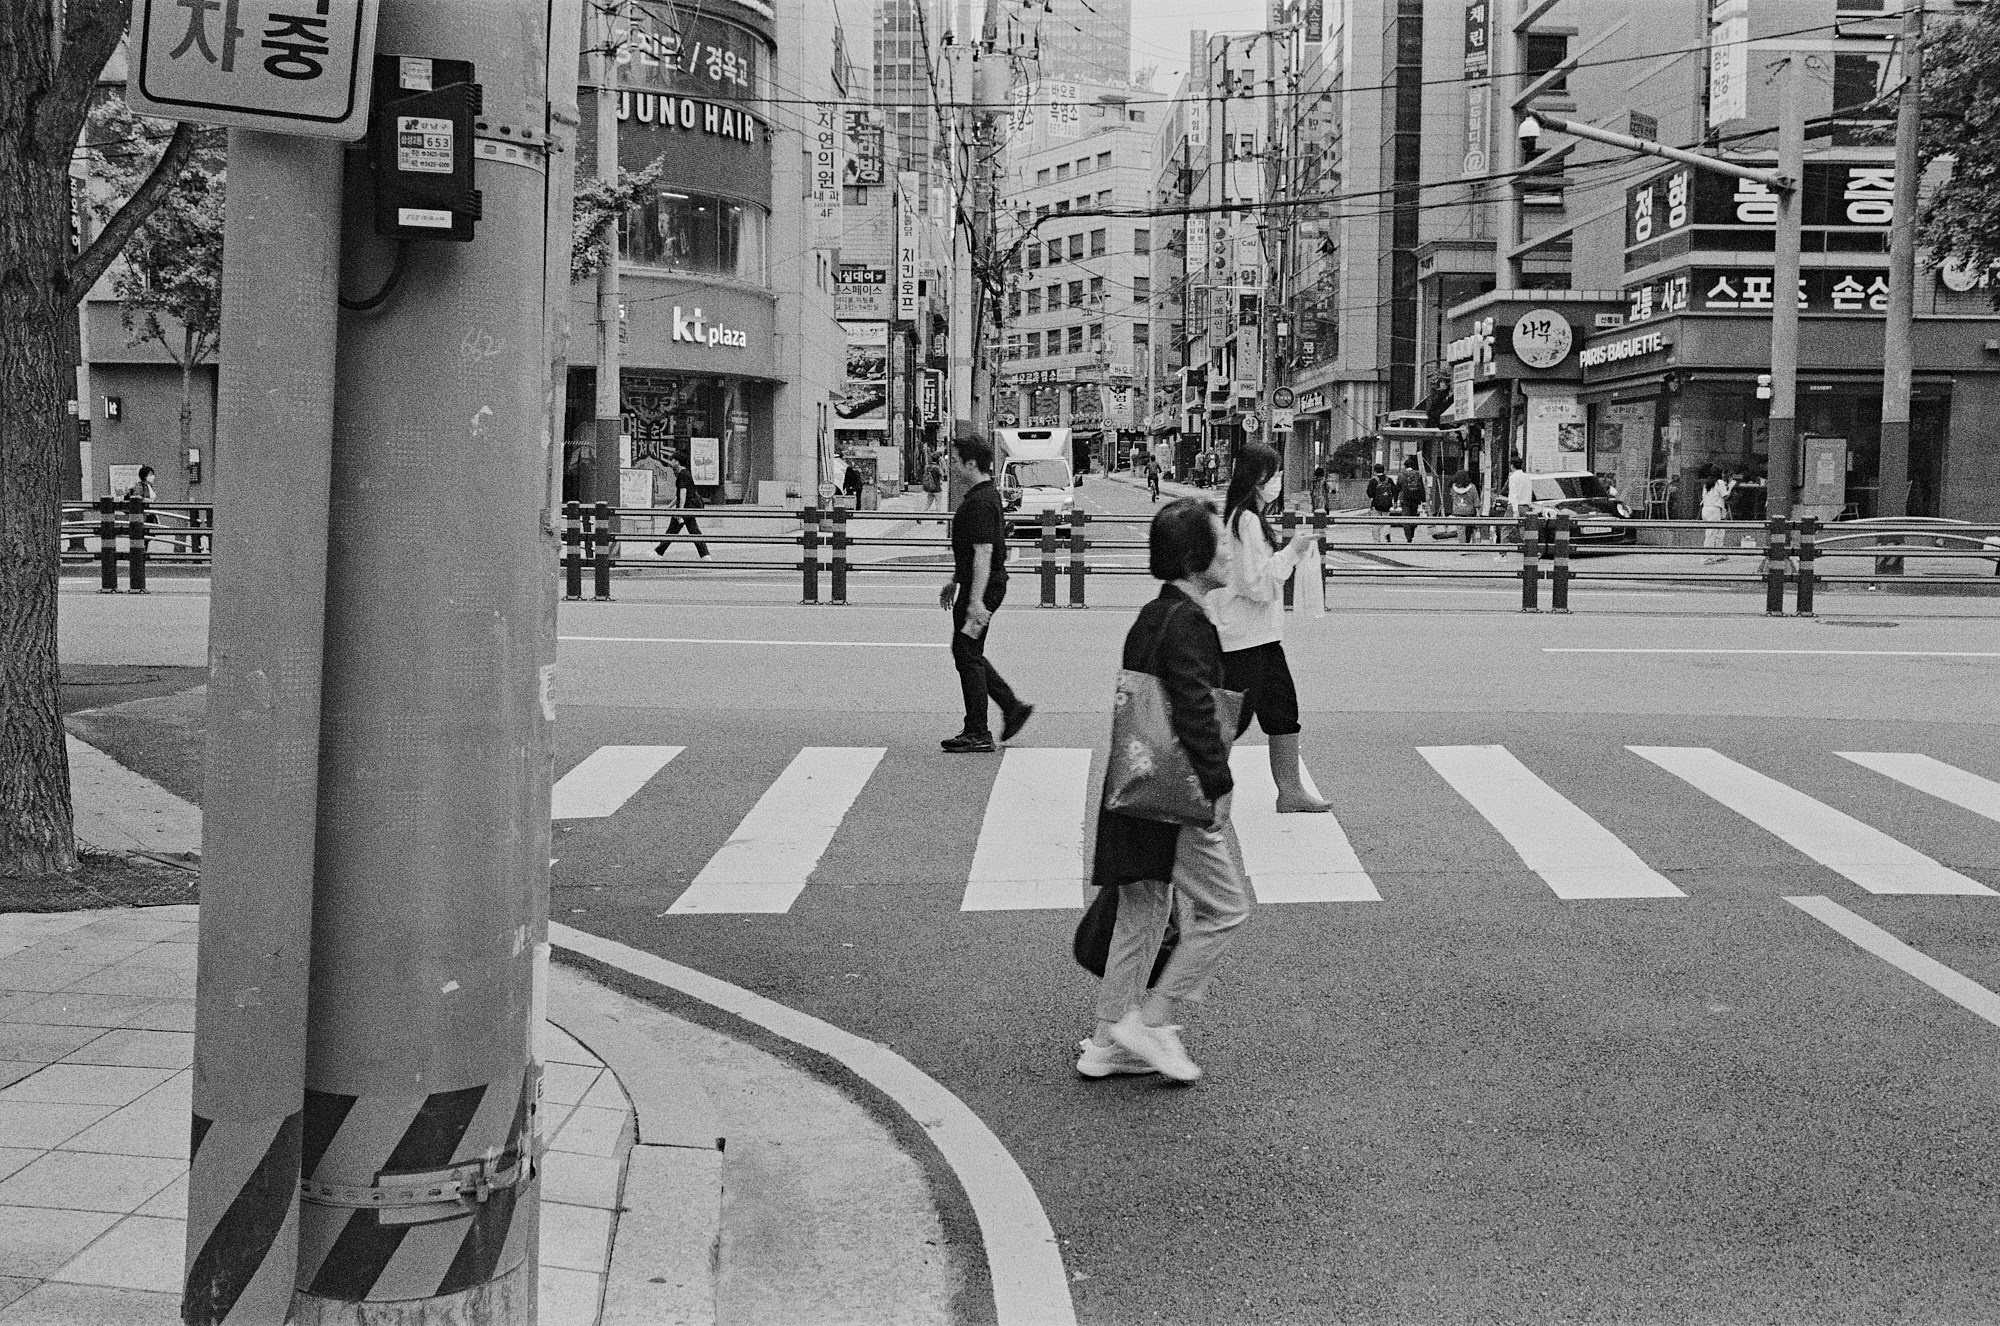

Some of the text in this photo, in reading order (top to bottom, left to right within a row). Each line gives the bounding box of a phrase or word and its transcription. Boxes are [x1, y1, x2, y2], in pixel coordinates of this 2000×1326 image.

[261, 0, 330, 80] 중
[705, 45, 749, 88] 경옥고
[617, 92, 755, 142] JUNO HAIR
[427, 137, 450, 148] 653
[817, 112, 836, 190] 자연의원
[820, 208, 834, 219] 4F
[1635, 171, 1688, 241] 정형
[839, 270, 874, 283] 실대여
[901, 248, 915, 312] 치킨호프
[1629, 285, 1653, 322] 교통
[1661, 276, 1687, 312] 사고
[673, 306, 746, 348] kt plaza
[1522, 320, 1551, 344] 나무
[1579, 331, 1664, 368] PARIS BAGUETTE
